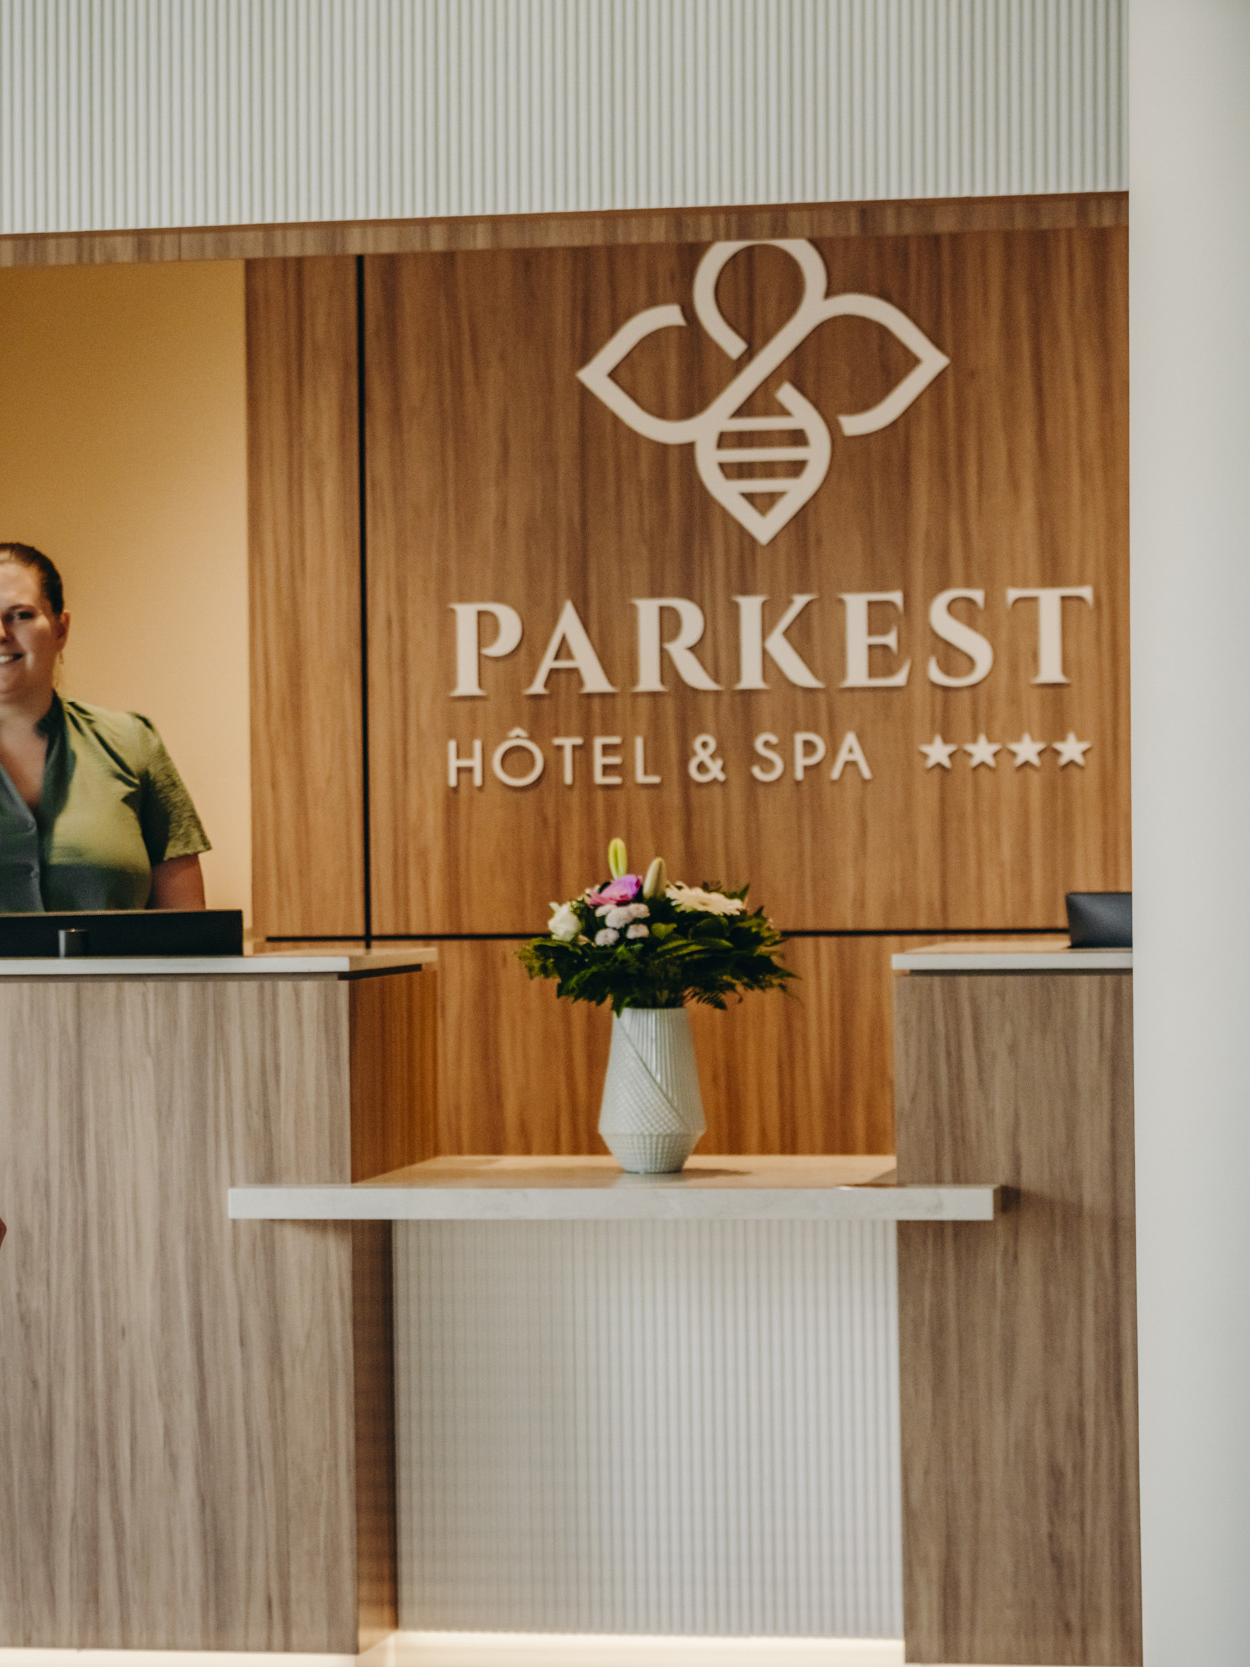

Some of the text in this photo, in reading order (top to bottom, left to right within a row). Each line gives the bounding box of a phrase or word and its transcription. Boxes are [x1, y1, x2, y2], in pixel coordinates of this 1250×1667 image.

[447, 586, 1094, 697] PARKEST
[447, 727, 873, 788] HÔTEL & SPA
